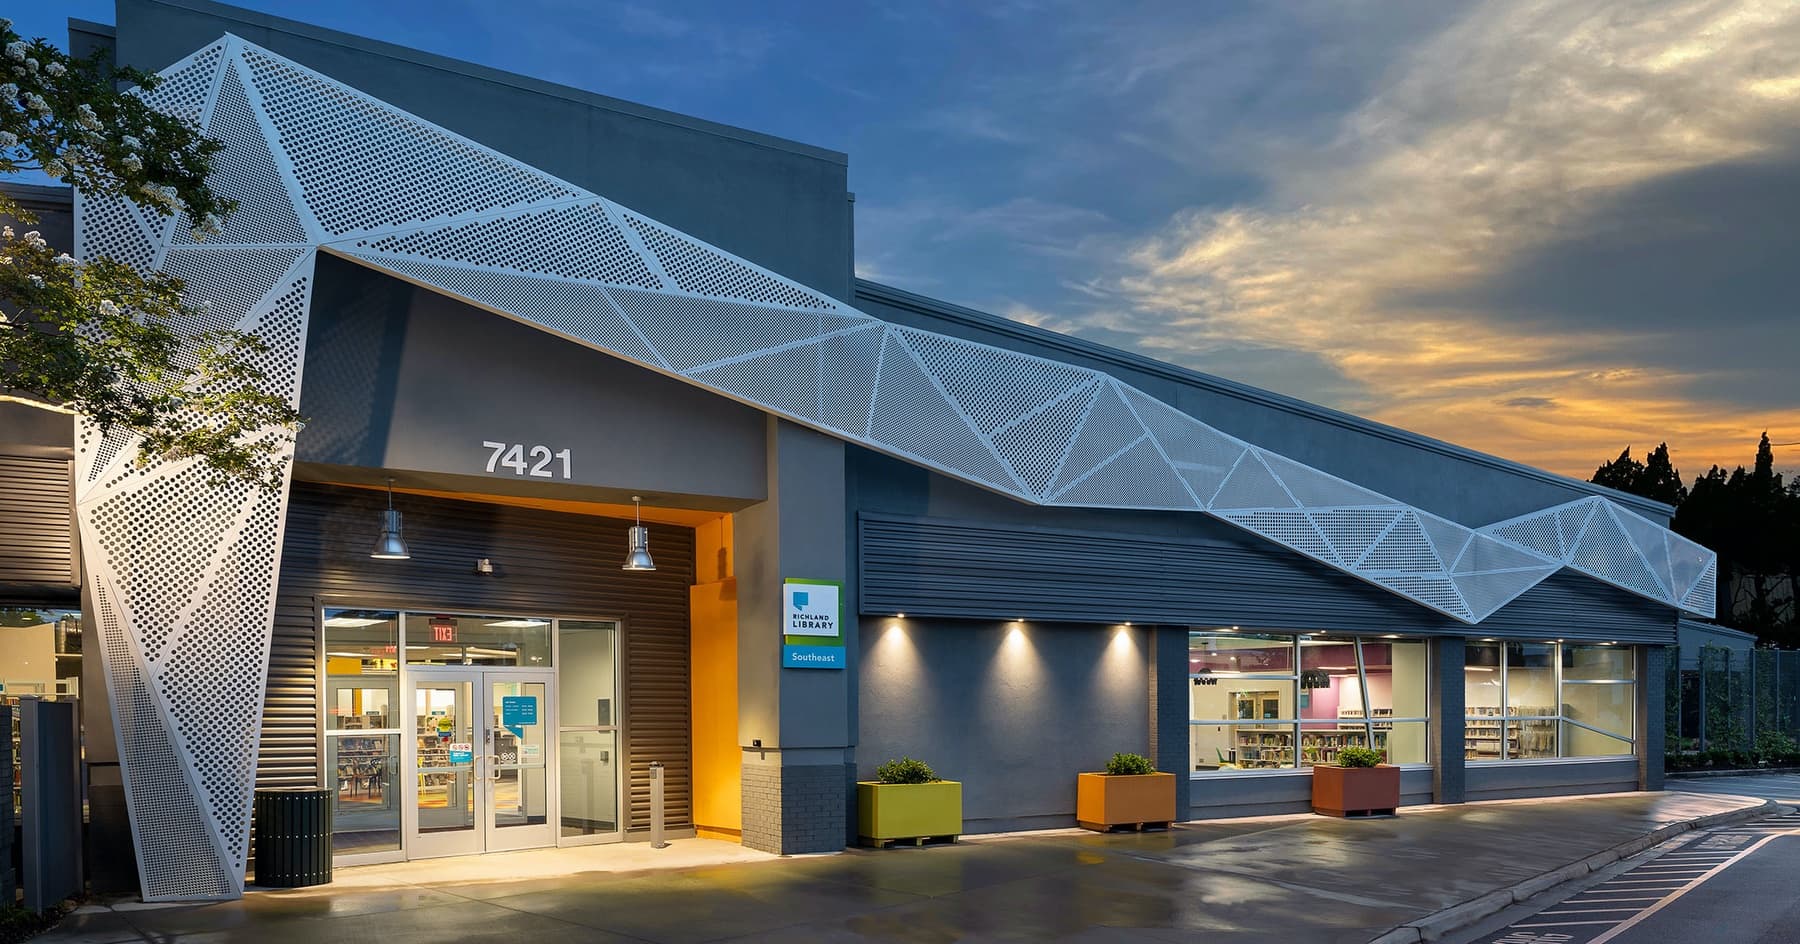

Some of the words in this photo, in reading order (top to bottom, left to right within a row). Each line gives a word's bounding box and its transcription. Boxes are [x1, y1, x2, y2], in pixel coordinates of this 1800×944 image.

[483, 440, 572, 479] 7421
[792, 613, 830, 621] RICHLAND
[792, 620, 834, 629] LIBRARY
[792, 652, 835, 662] Southeast
